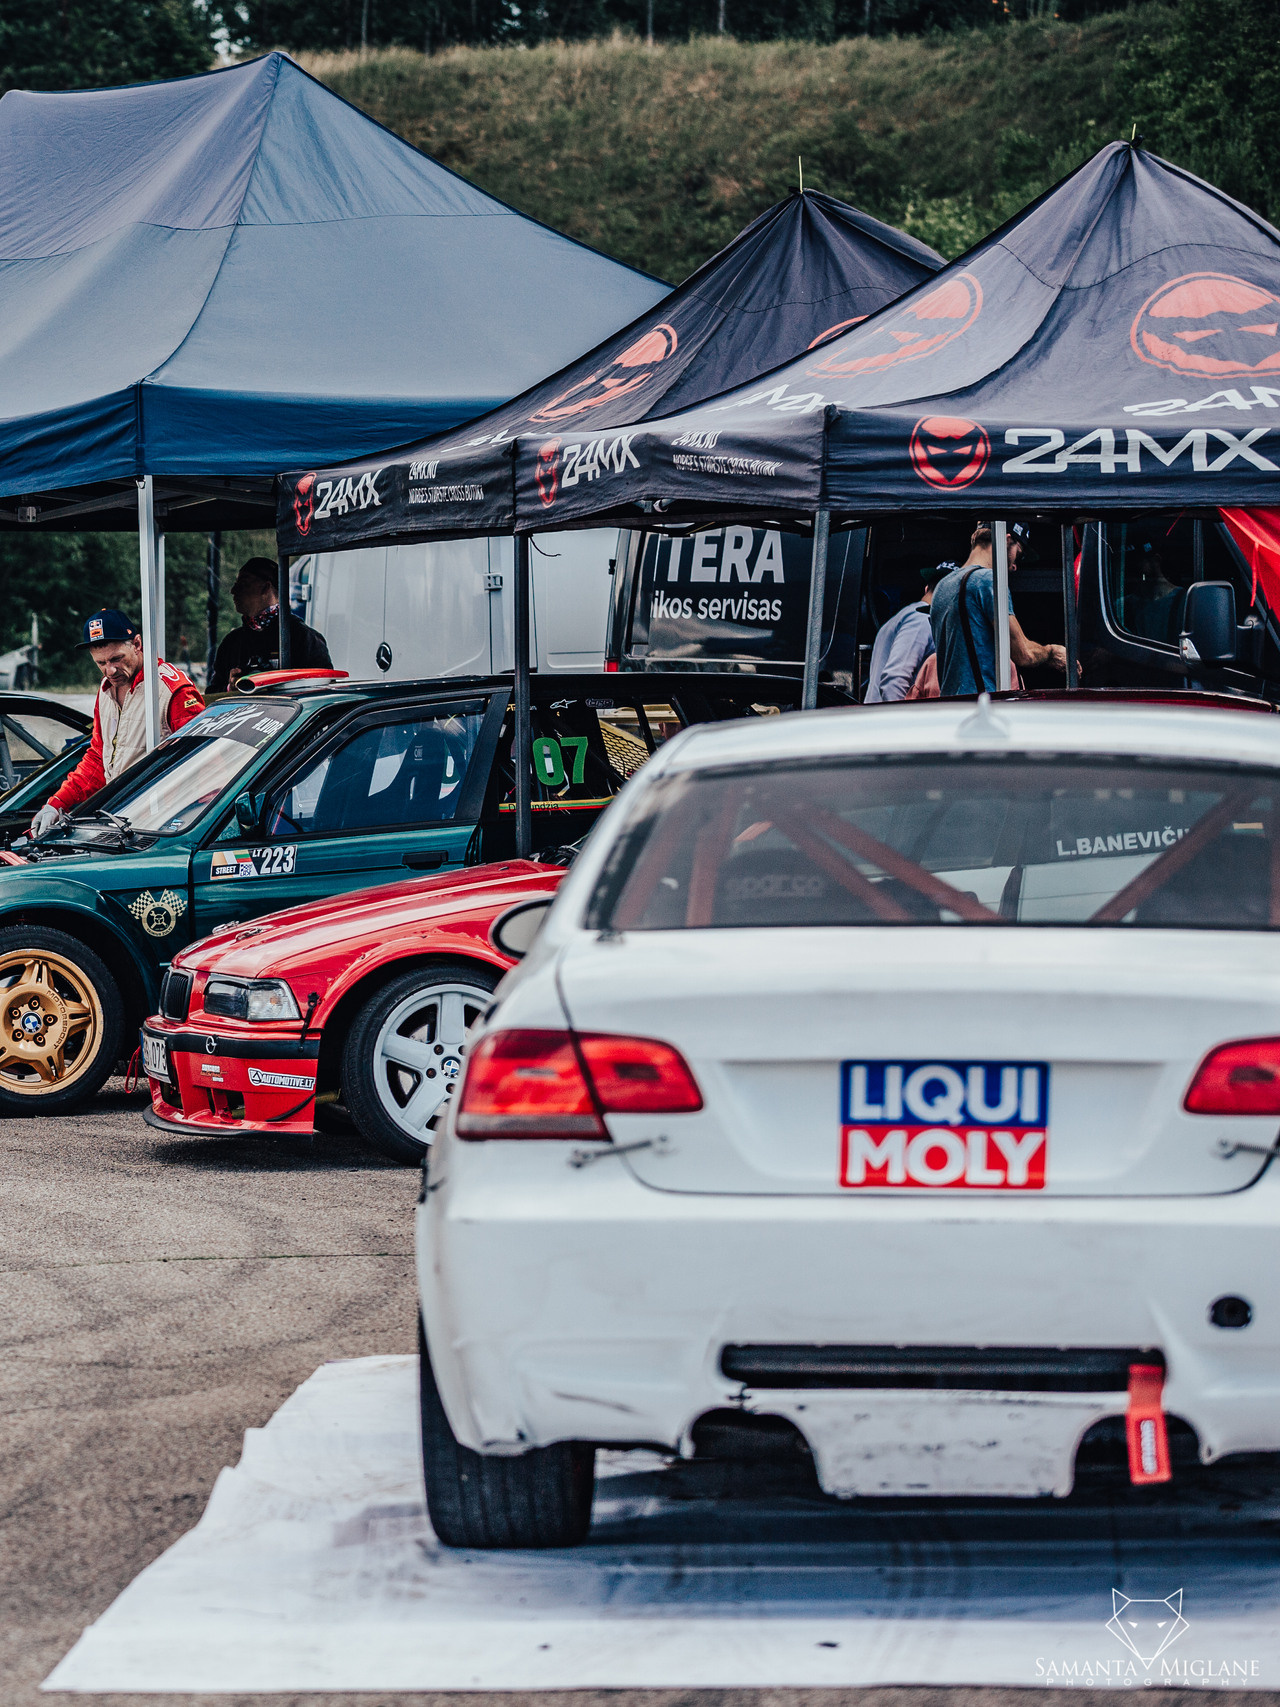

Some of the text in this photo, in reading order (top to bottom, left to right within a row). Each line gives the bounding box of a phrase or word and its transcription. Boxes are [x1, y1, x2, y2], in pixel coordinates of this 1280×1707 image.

[561, 433, 641, 488] 24MX
[1001, 428, 1280, 474] 24MX
[314, 469, 382, 520] 24MX
[654, 525, 786, 584] TERA
[651, 590, 783, 622] ikos servisas
[532, 736, 589, 787] 07
[252, 848, 263, 858] LT
[259, 845, 295, 874] 223
[1056, 825, 1191, 858] L.BANEVIČI
[215, 865, 238, 875] STREET
[46, 989, 68, 1050] MOTORSPORT
[849, 1063, 1040, 1126] LIQUI
[845, 1127, 1046, 1186] MOLY
